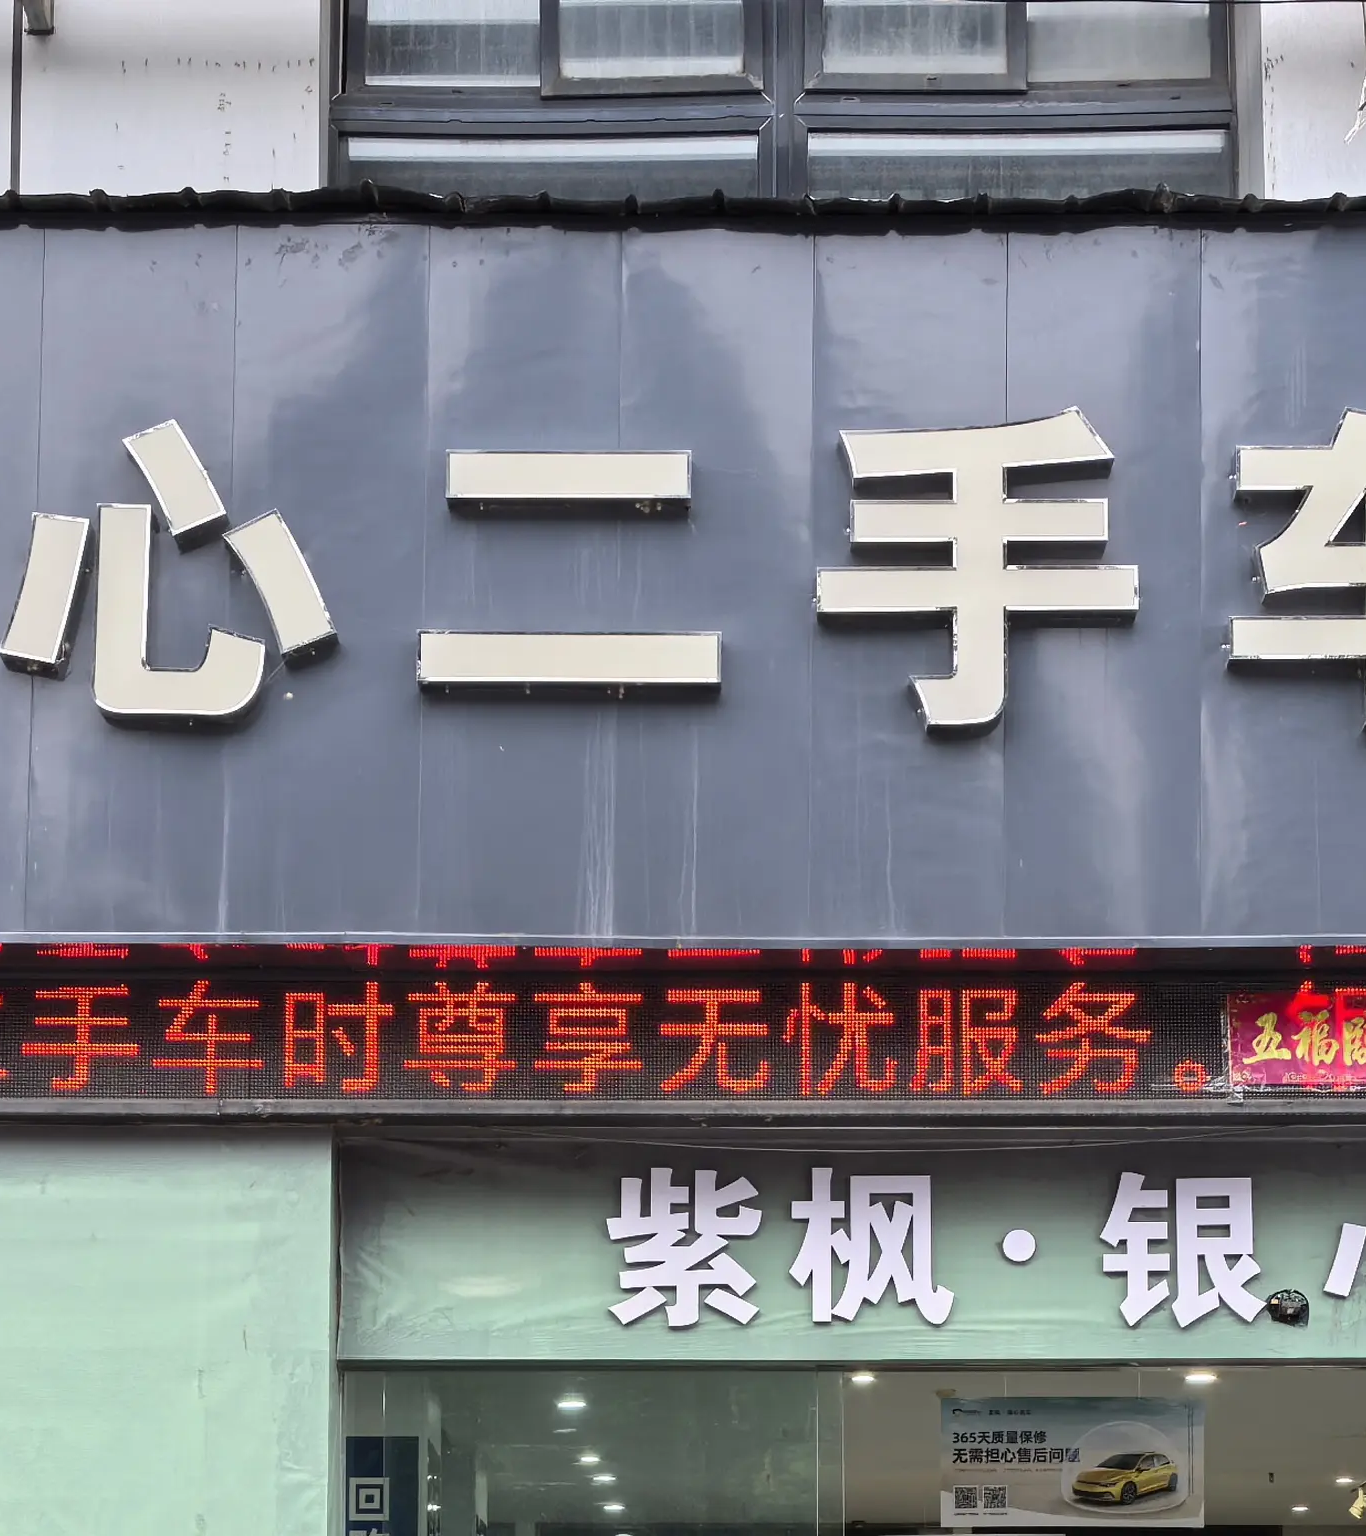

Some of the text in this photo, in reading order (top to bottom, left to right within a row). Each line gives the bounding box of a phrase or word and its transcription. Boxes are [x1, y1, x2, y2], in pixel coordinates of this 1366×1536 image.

[952, 1431, 1048, 1445] 365天质量保修
